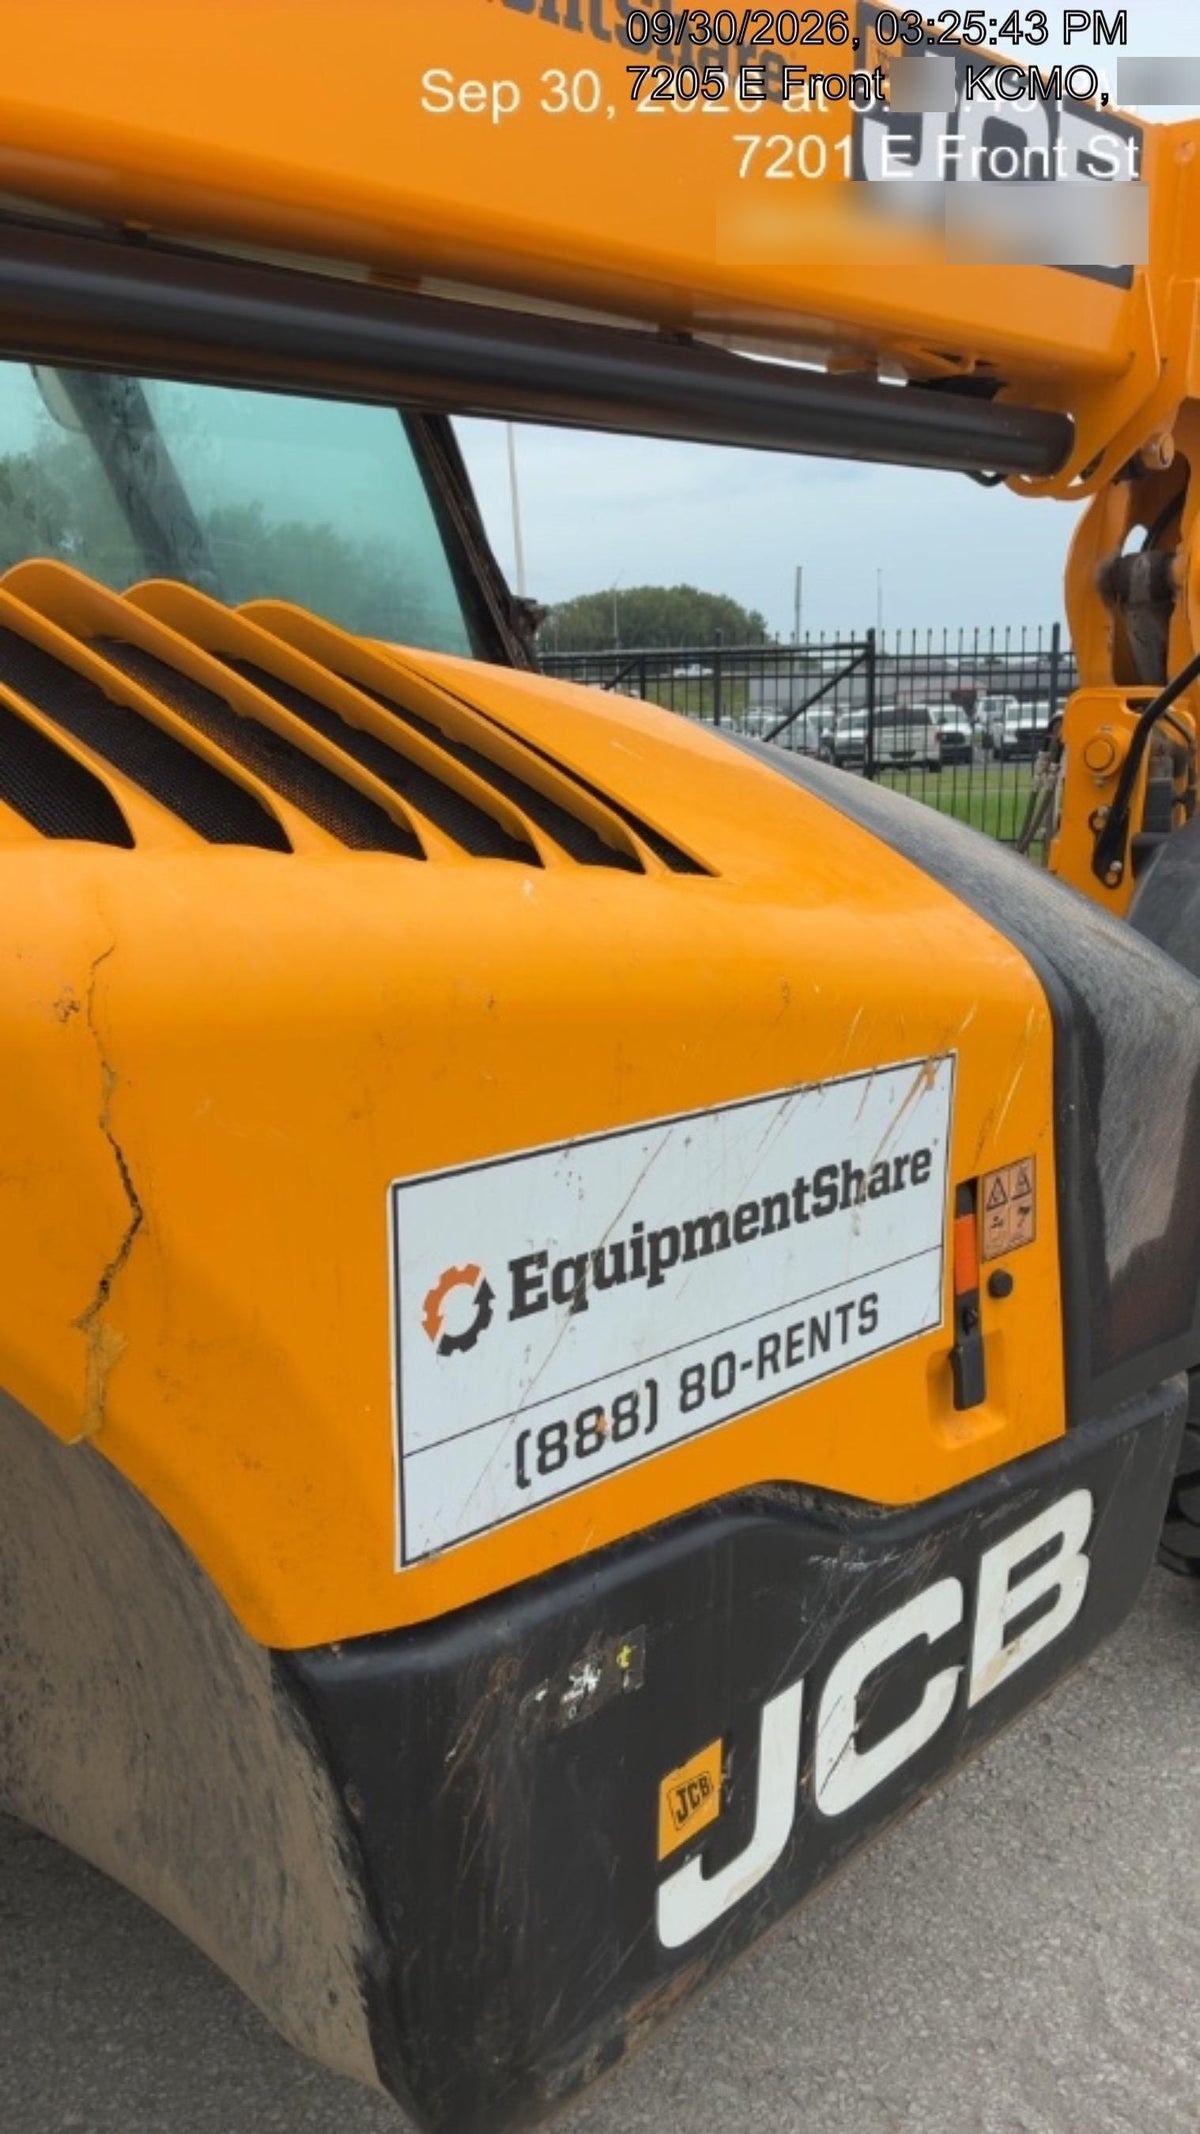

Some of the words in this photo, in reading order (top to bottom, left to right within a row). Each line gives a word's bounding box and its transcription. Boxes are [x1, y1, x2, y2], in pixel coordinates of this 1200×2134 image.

[507, 1147, 932, 1322] EquipmentShare
[515, 1379, 658, 1490] (888)
[679, 1293, 879, 1414] 80-RENTS
[658, 1488, 1094, 1949] JCB
[676, 1775, 711, 1823] JCB
